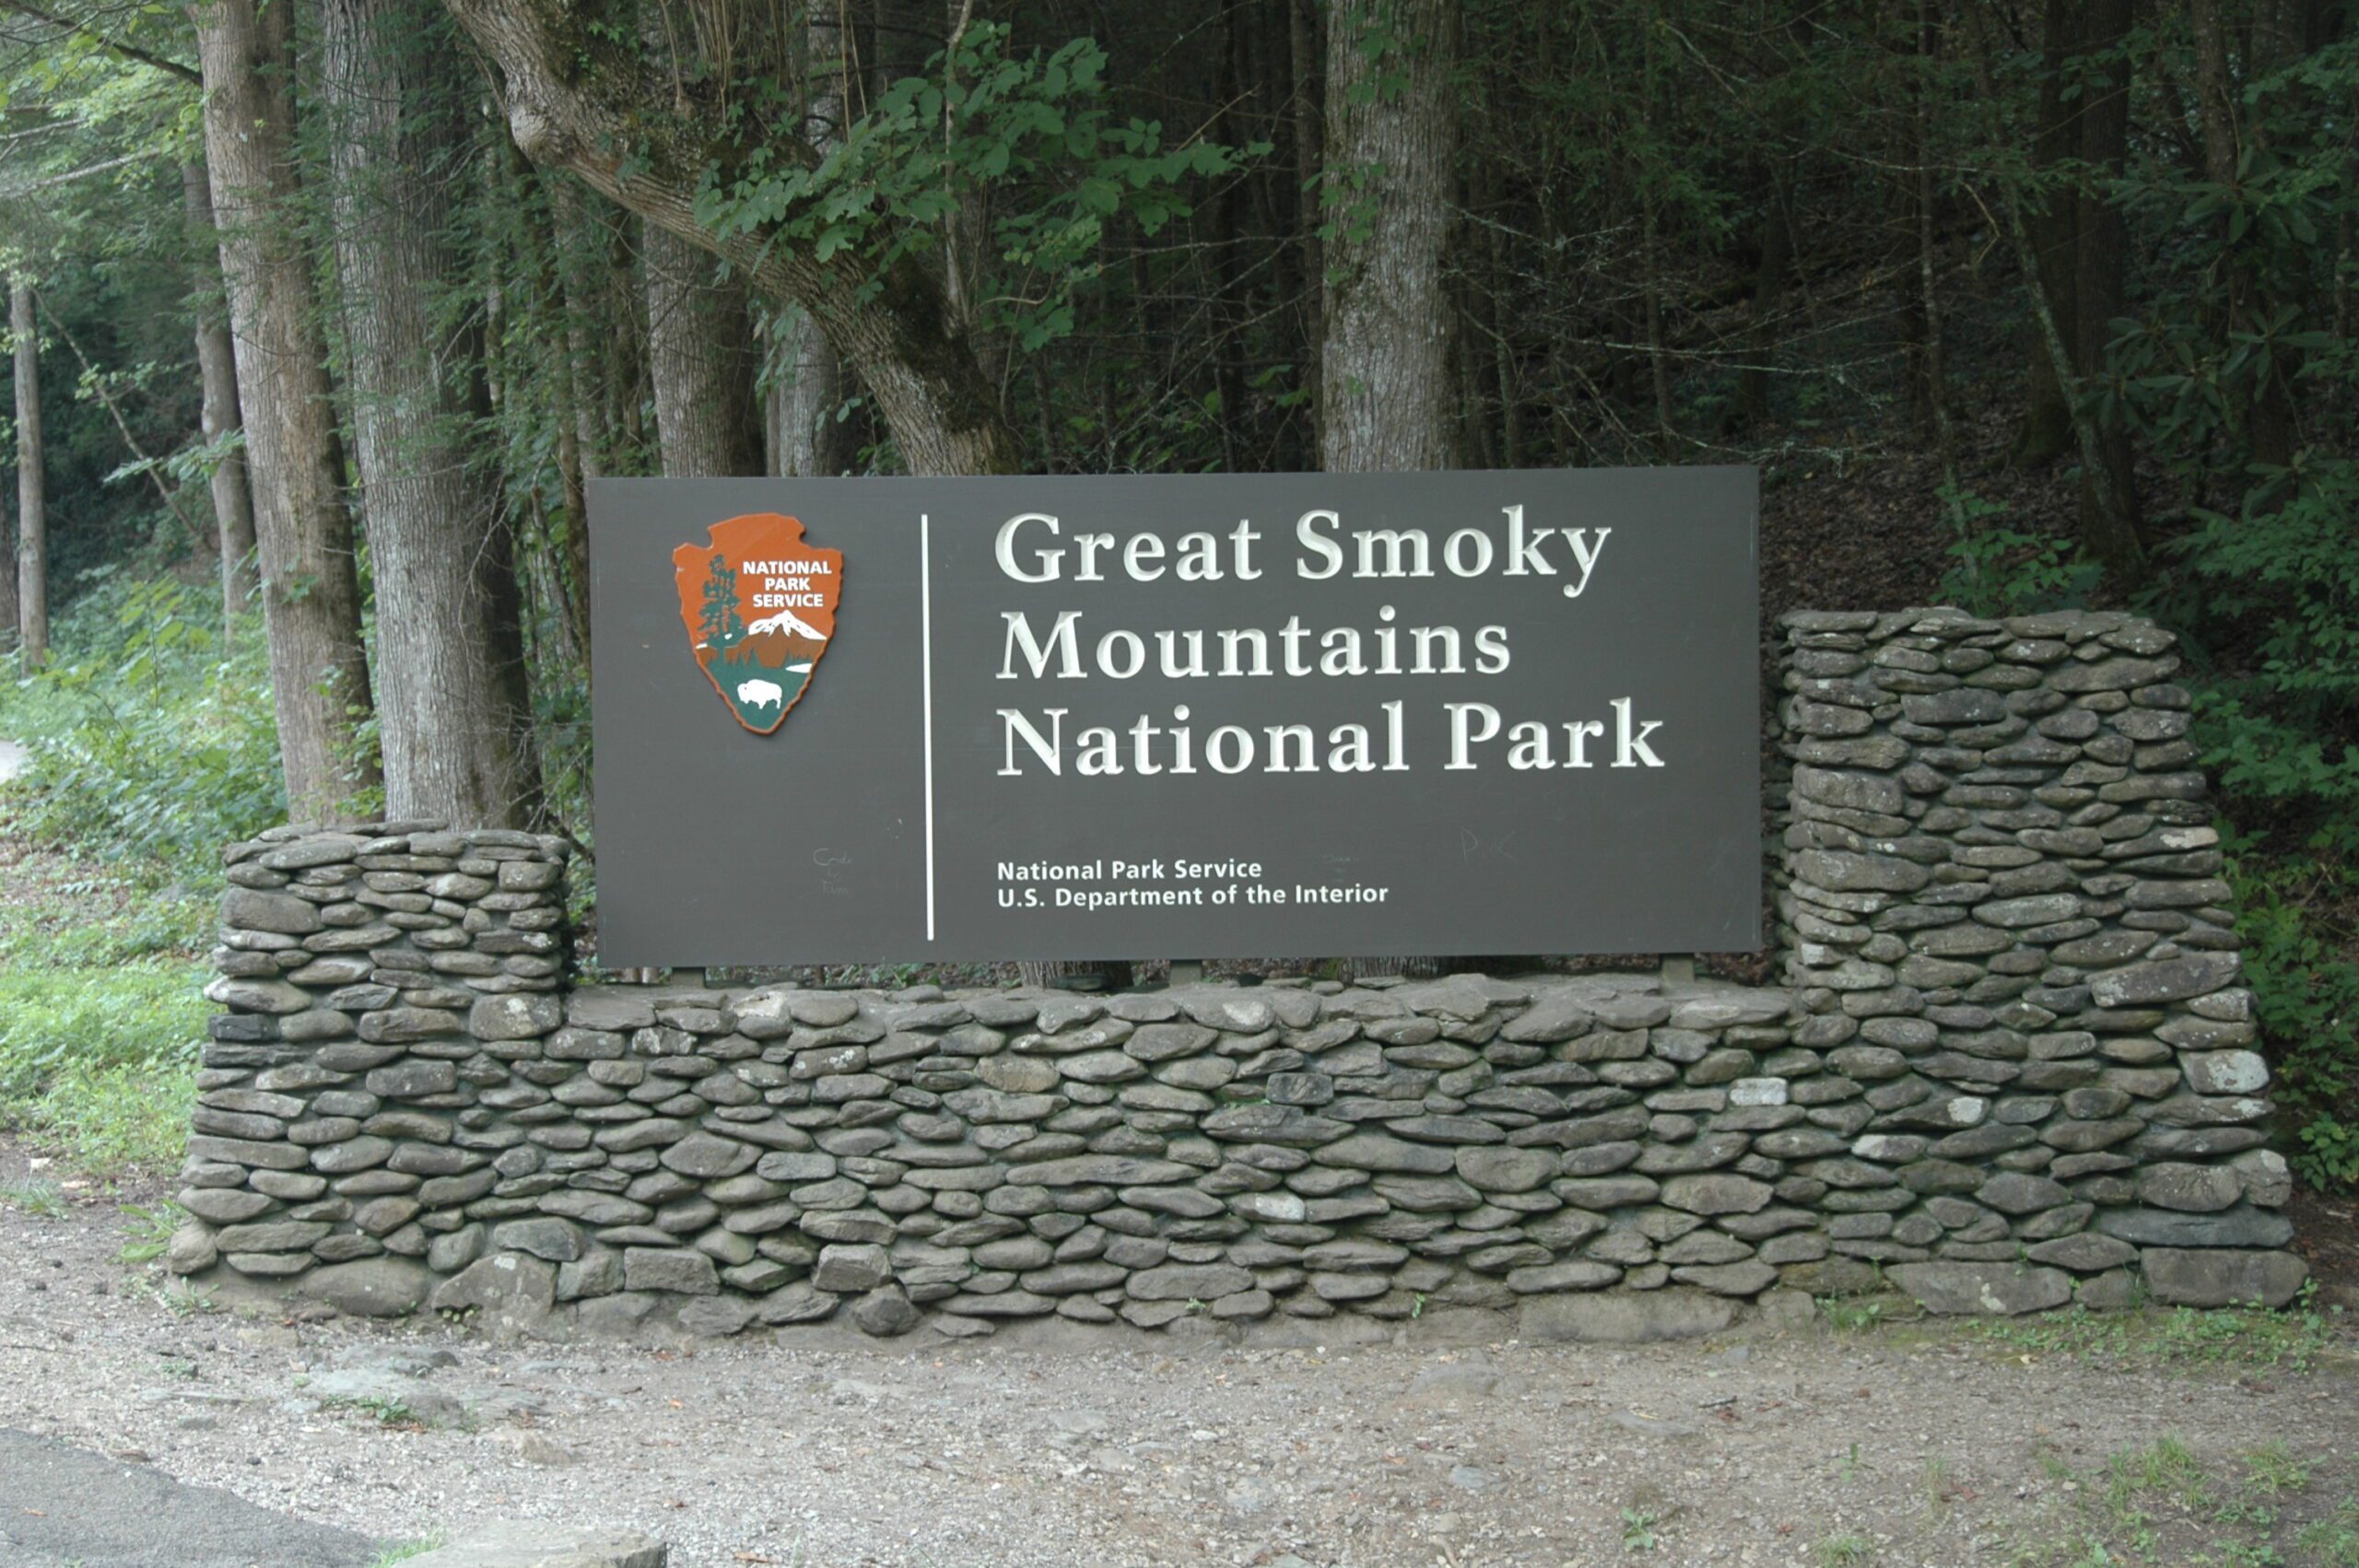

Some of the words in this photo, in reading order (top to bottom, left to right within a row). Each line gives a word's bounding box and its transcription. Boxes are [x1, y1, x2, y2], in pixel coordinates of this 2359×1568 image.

[994, 512, 1263, 584] Great
[1296, 504, 1613, 599] Smoky
[743, 561, 832, 574] NATIONAL
[765, 578, 811, 591] PARK
[753, 593, 823, 607] SERVICE
[995, 604, 1511, 681] Mountains
[995, 699, 1411, 778] National
[1443, 696, 1666, 771] Park
[997, 860, 1103, 881] National
[1111, 858, 1166, 880] Park
[1174, 858, 1263, 880] Service
[997, 887, 1046, 907] U.S.
[1055, 887, 1204, 911] Department
[1211, 883, 1238, 906] of
[1245, 883, 1287, 905] the
[1296, 883, 1390, 904] Interior
